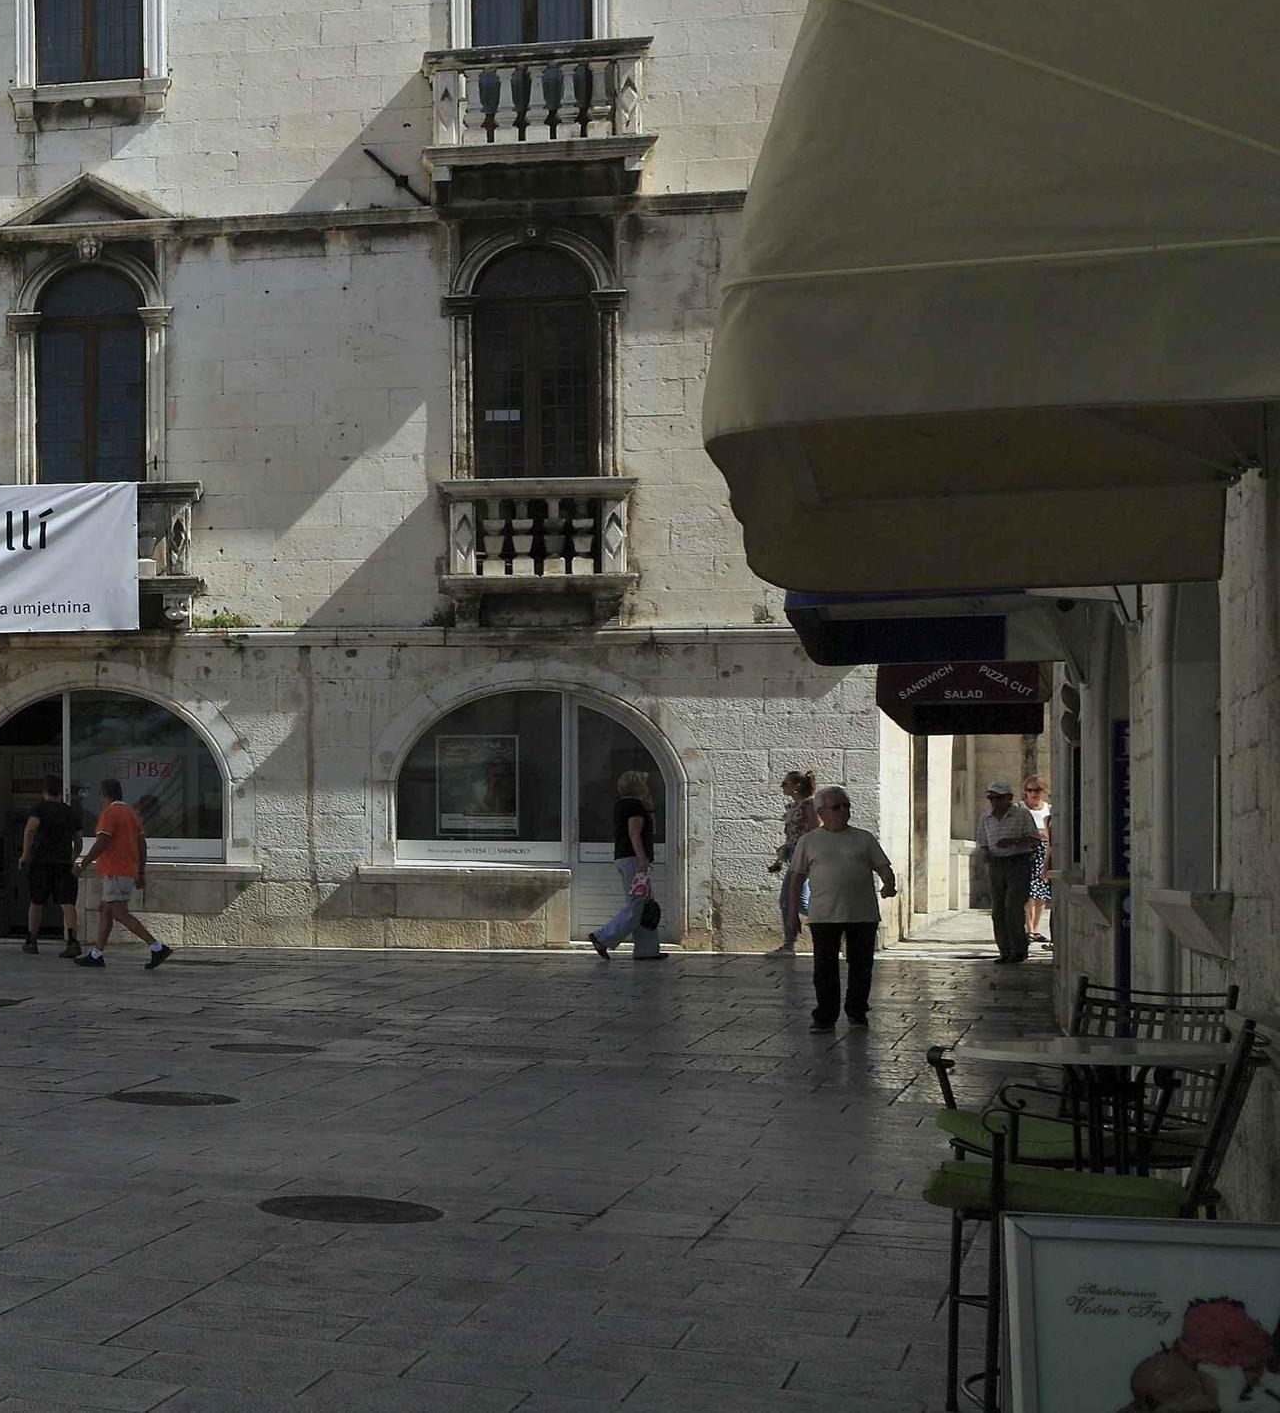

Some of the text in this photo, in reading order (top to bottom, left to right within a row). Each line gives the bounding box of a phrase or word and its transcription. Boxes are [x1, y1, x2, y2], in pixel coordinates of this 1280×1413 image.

[13, 601, 91, 618] umjetnina
[898, 664, 1034, 700] SANDWICH PIZZA CUT
[944, 690, 983, 699] SALAD
[135, 762, 173, 777] PBZ
